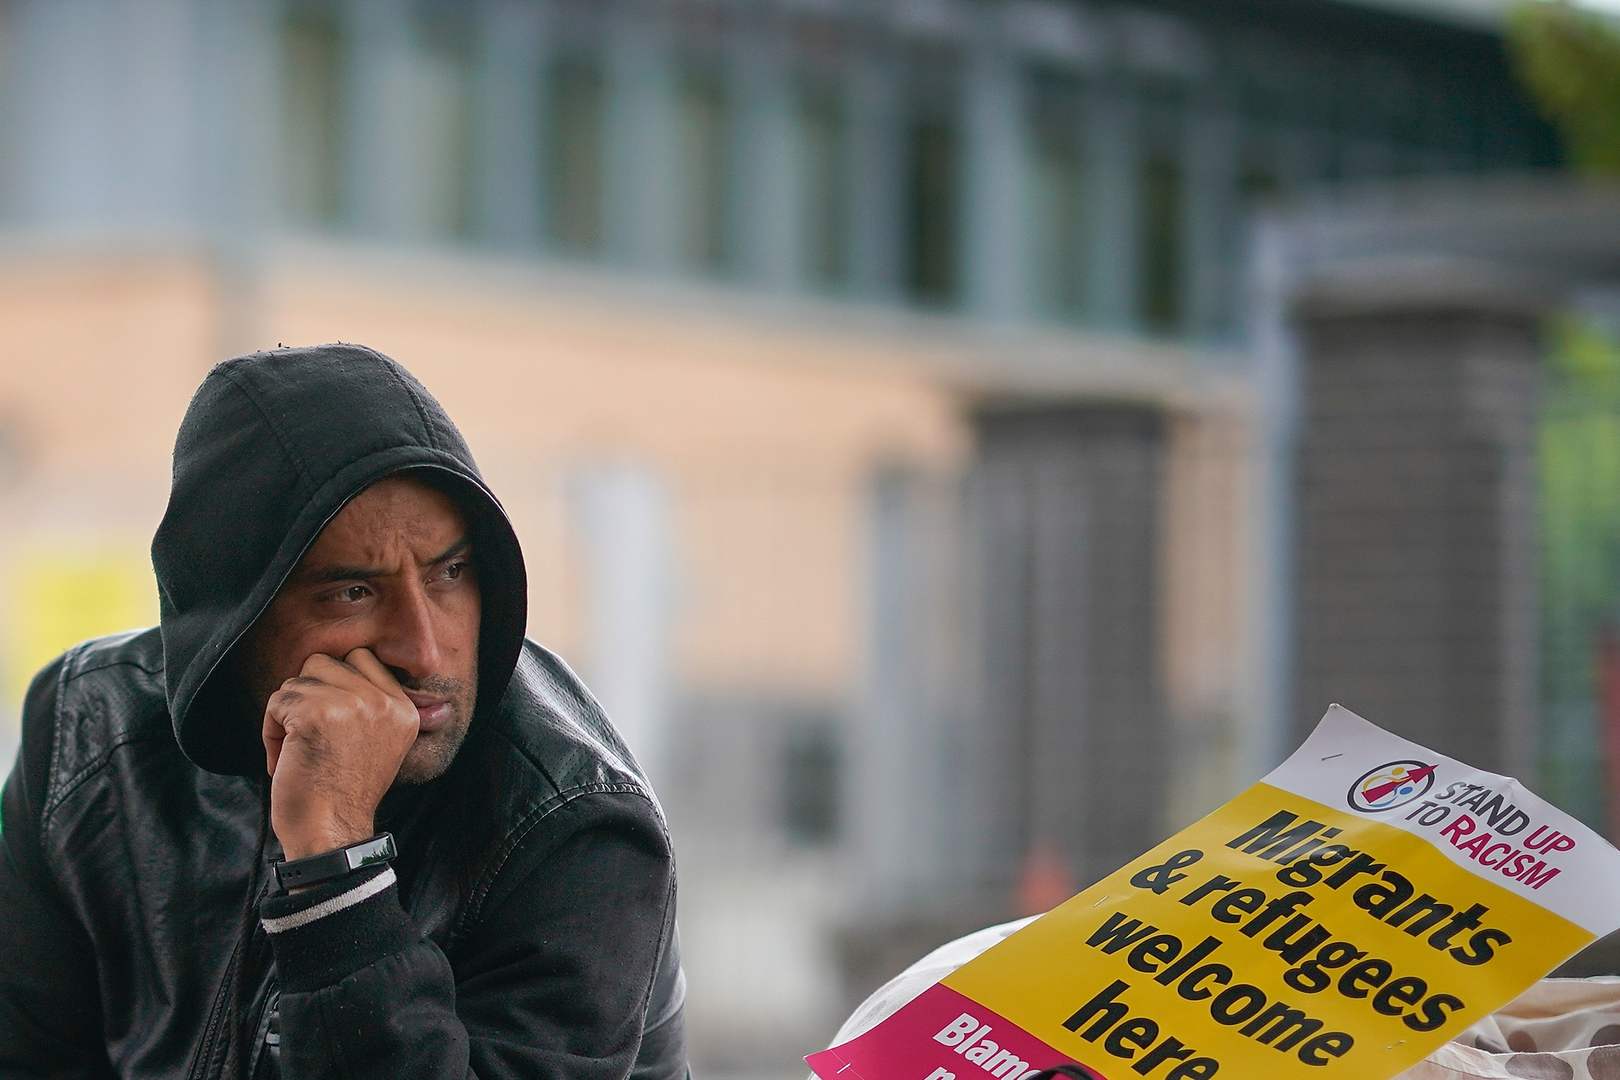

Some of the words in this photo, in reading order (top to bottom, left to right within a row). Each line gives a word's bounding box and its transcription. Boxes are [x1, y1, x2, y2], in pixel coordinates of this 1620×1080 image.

[1224, 809, 1513, 966] Migrants
[1404, 800, 1451, 826] TO
[1440, 814, 1562, 890] RACISM
[1434, 781, 1530, 837] STAND
[1522, 824, 1576, 855] UP
[1084, 911, 1355, 1067] welcome
[1129, 849, 1204, 895] &
[1178, 874, 1466, 1032] refugees
